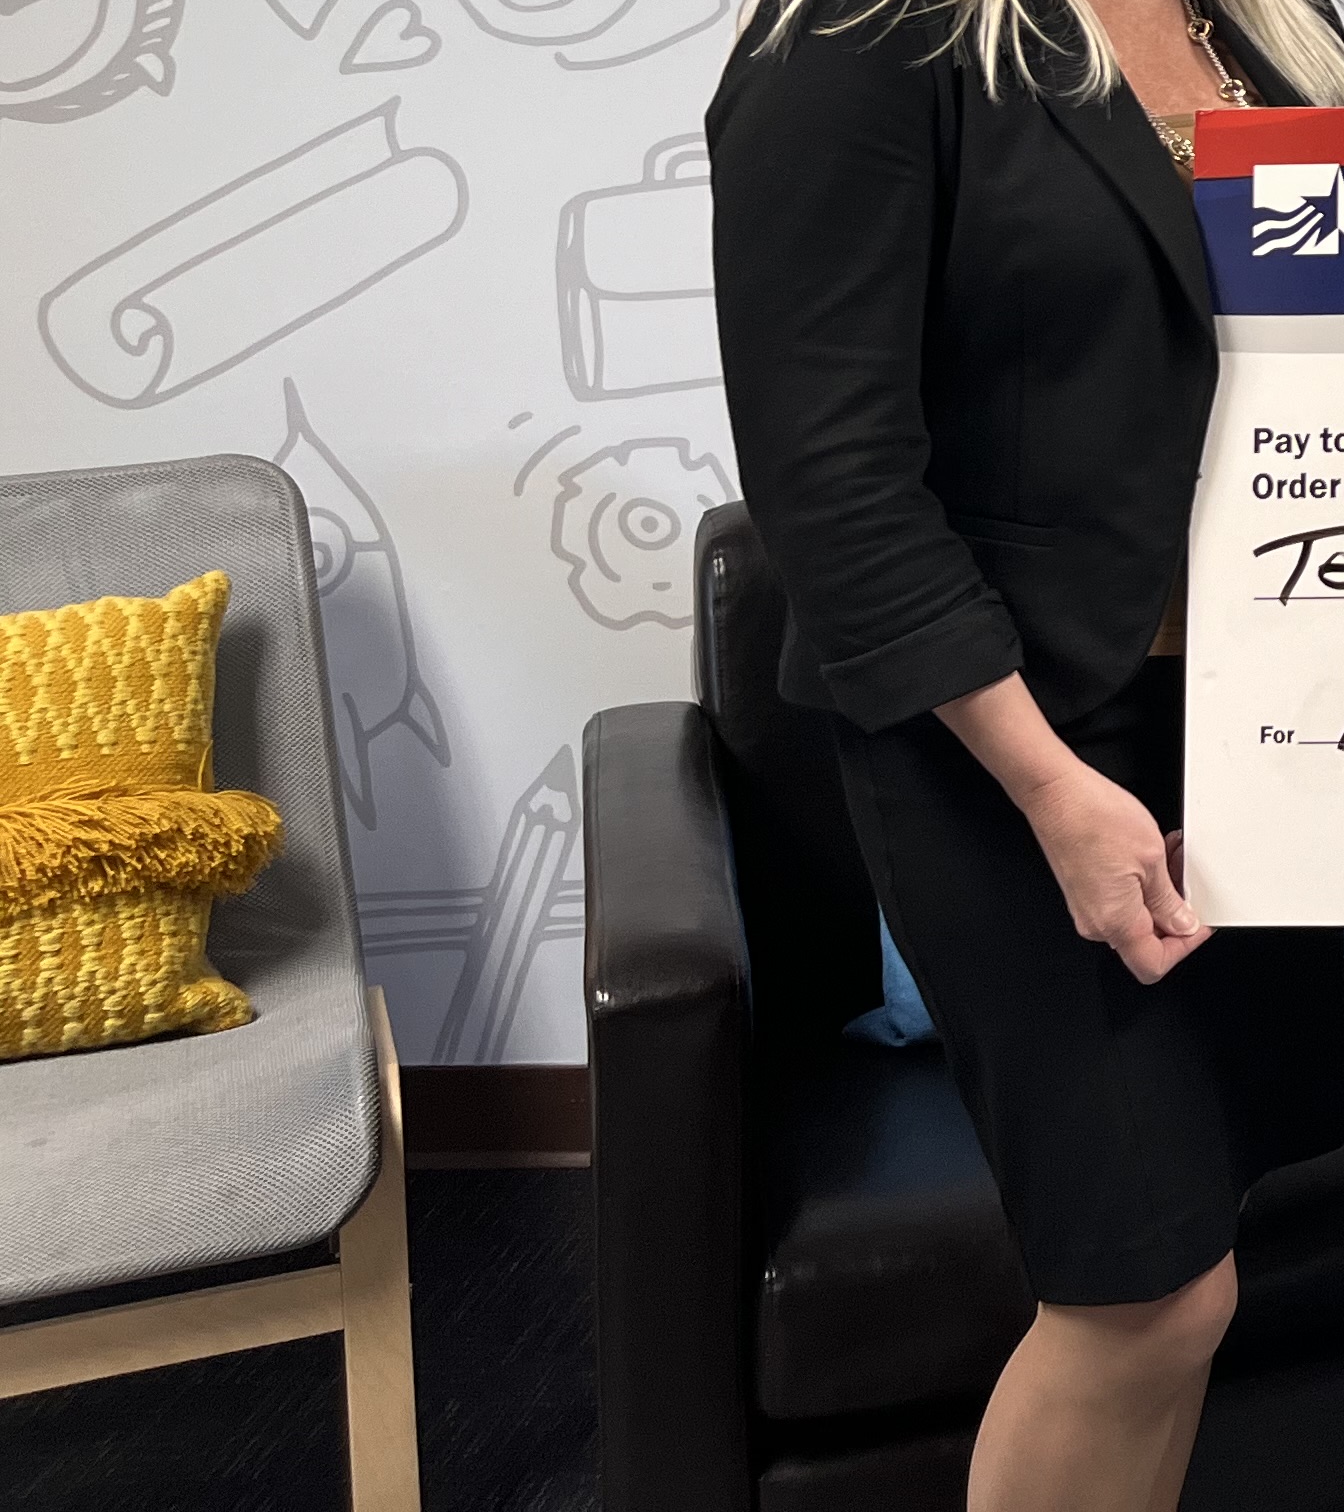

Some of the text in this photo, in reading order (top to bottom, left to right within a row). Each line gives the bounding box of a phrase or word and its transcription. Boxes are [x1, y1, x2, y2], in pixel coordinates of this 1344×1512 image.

[1253, 427, 1311, 459] Pay
[1252, 472, 1343, 501] Order
[1259, 724, 1296, 745] For
